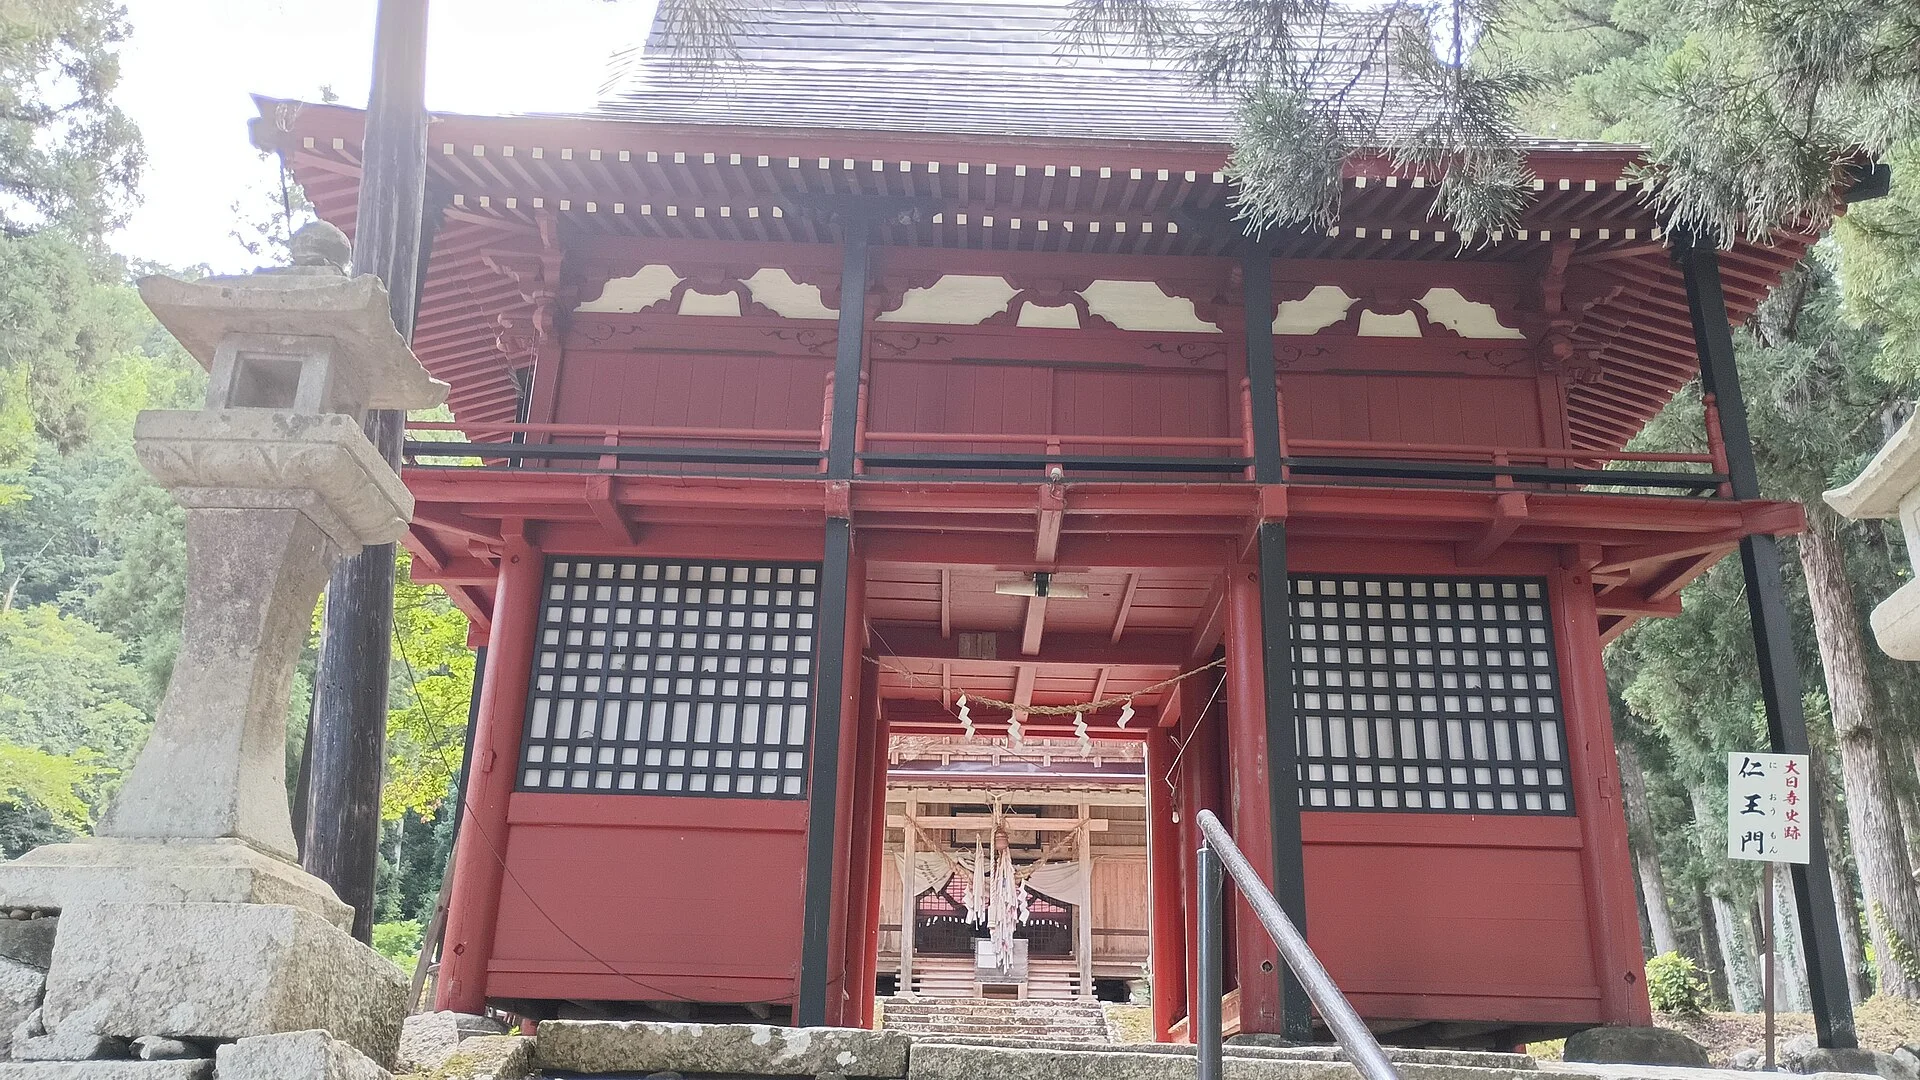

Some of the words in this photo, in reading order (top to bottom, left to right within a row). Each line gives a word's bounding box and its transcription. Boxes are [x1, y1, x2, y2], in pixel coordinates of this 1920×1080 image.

[1738, 757, 1766, 855] 仁王門
[1783, 760, 1801, 840] 大日寺史跡
